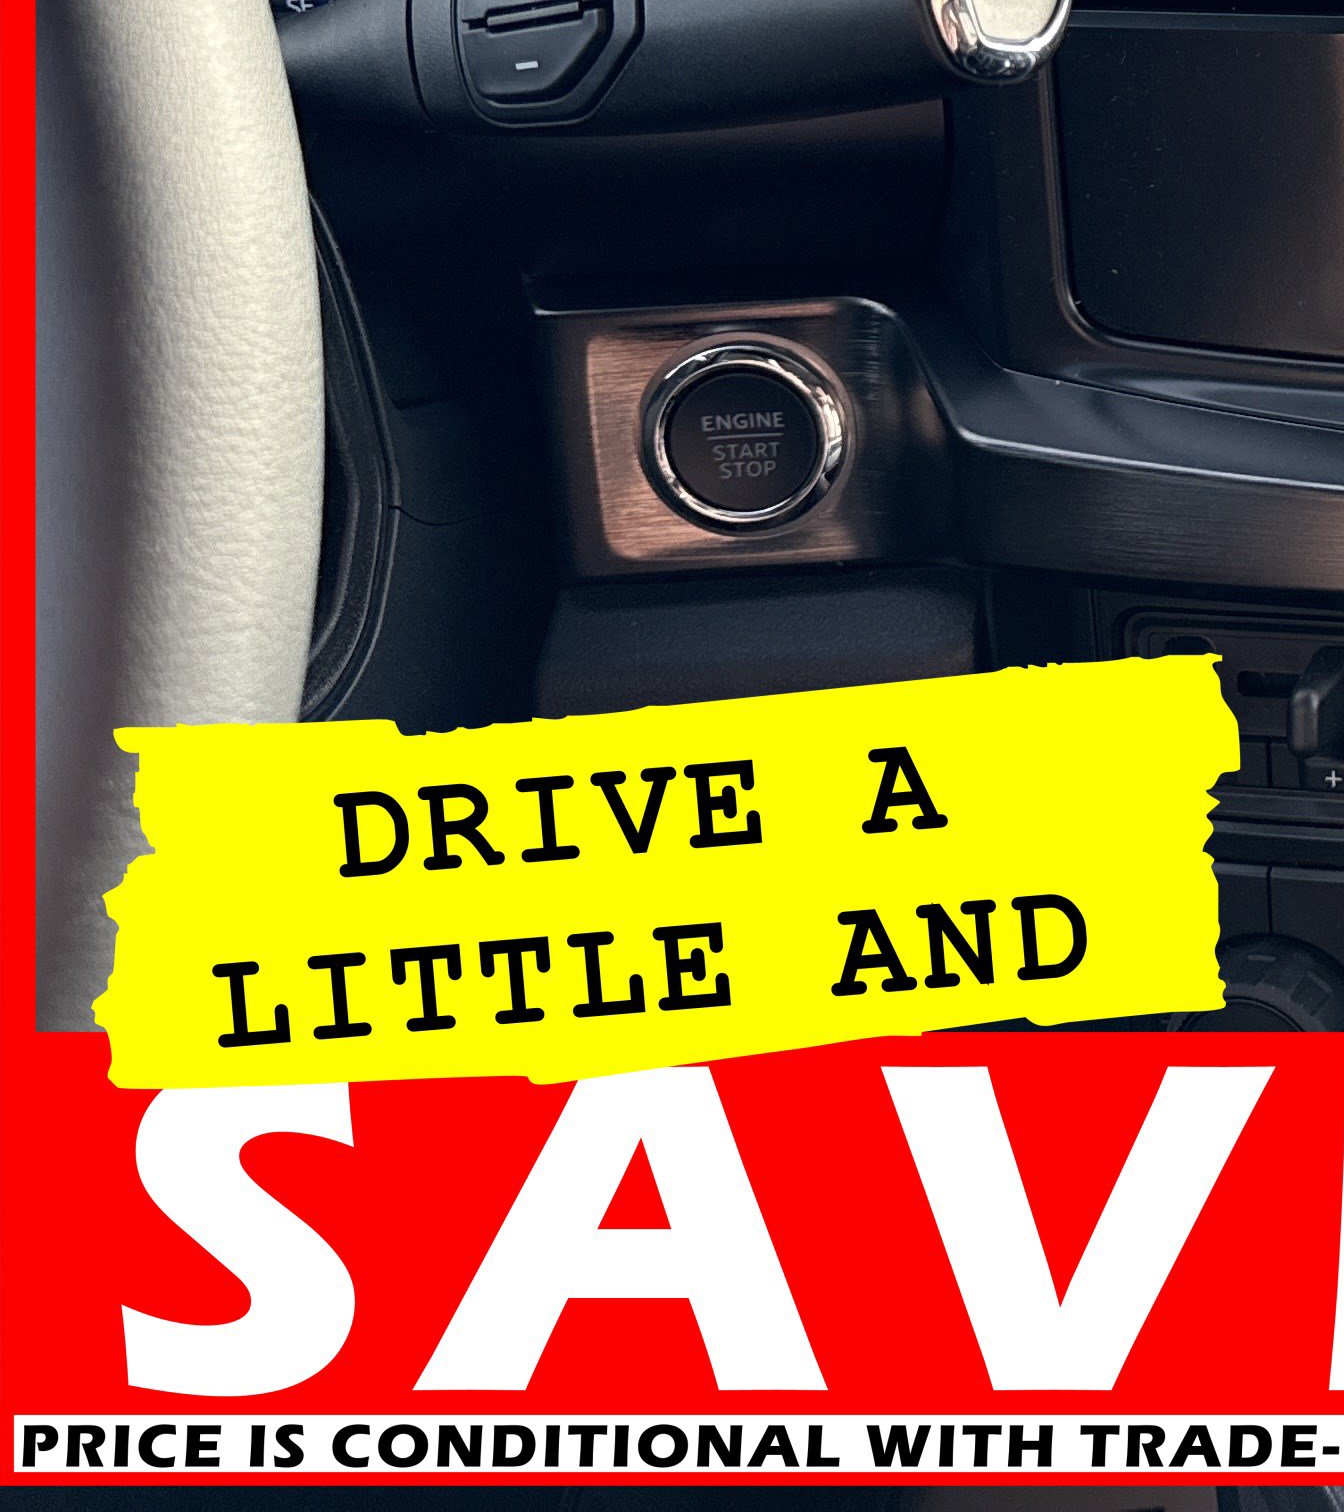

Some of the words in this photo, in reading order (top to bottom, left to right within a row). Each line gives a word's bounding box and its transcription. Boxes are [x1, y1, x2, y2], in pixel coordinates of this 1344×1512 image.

[701, 411, 785, 432] ENGINE
[712, 441, 780, 461] START
[719, 460, 777, 479] STOP
